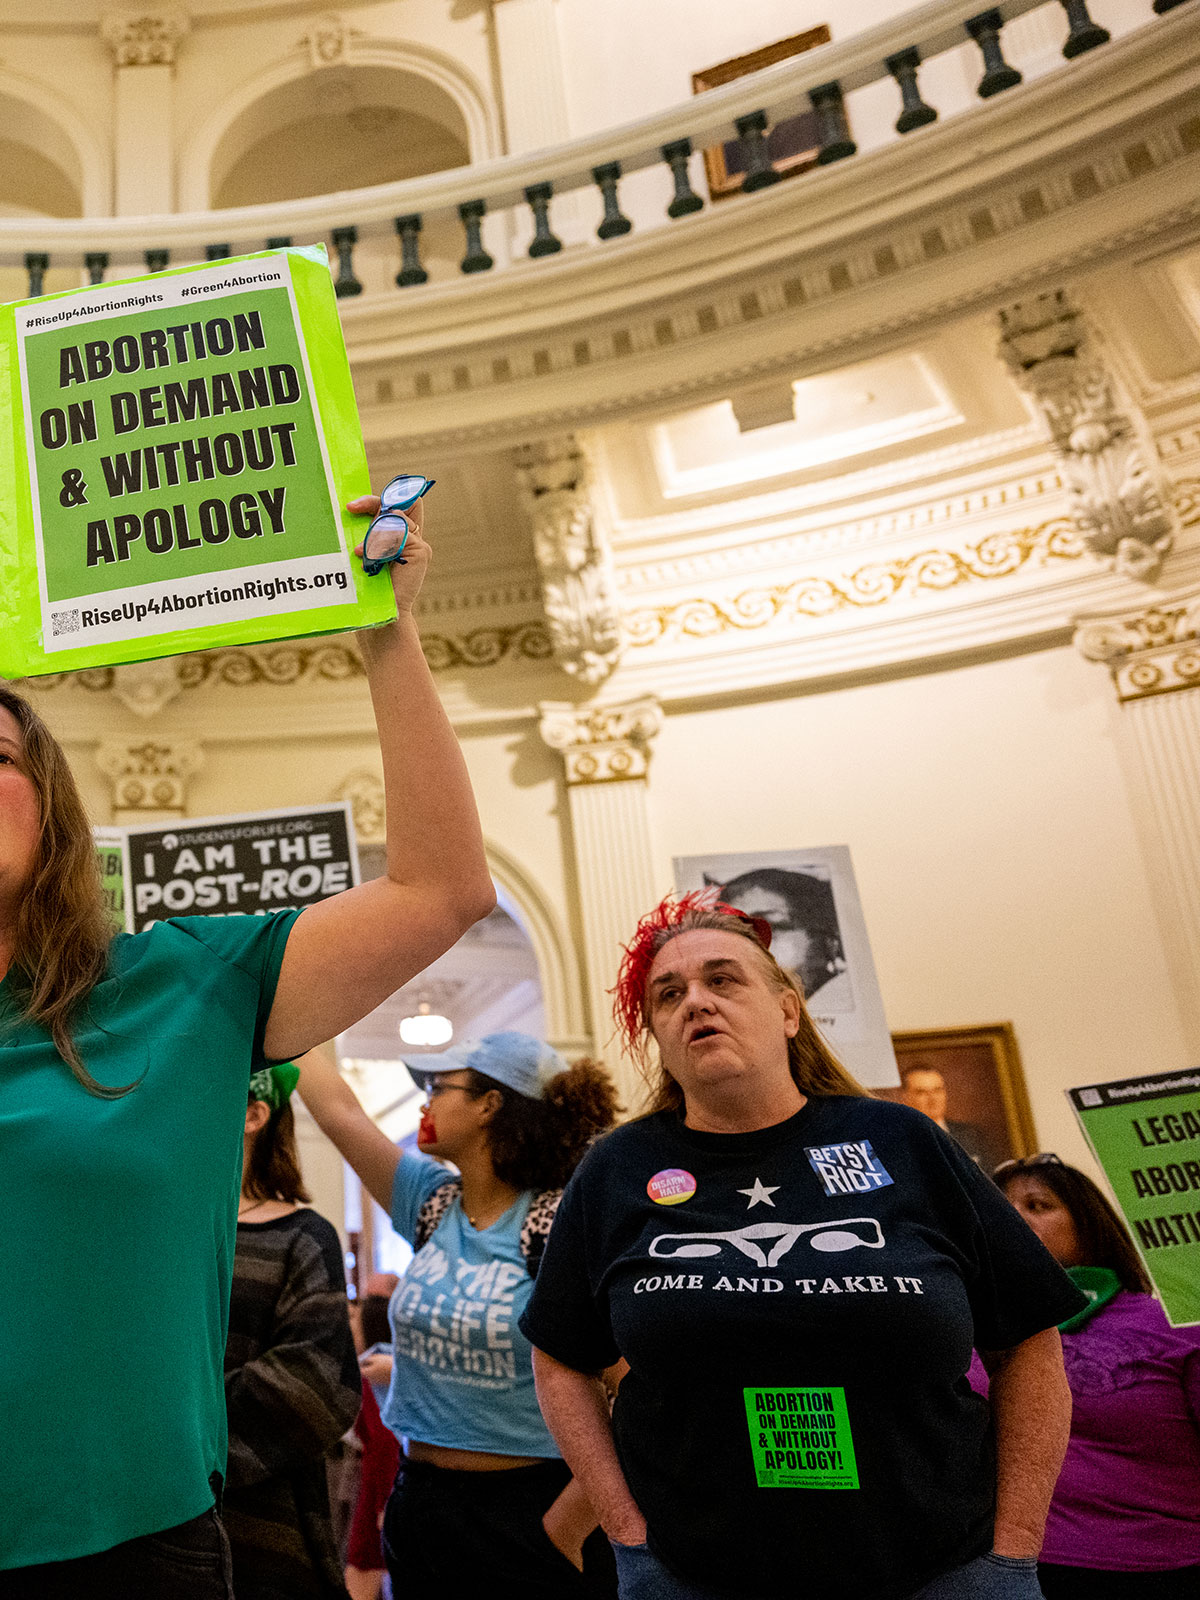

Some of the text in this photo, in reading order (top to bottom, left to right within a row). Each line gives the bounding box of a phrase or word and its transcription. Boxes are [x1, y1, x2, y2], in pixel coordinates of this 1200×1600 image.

[26, 272, 281, 328] #RiseUp4AbortionRights #Green4Abortion
[59, 311, 267, 388] ABORTION
[40, 363, 301, 450] ON DEMAND
[59, 423, 297, 509] & WITHOUT
[86, 486, 287, 567] APOLOGY
[81, 571, 347, 628] RiseUp4AbortionRights.org
[144, 833, 333, 877] I AM THE
[136, 861, 349, 914] POST-ROE
[809, 1143, 876, 1171] BETSY
[651, 1176, 685, 1191] DISARM
[660, 1185, 681, 1197] HATE
[816, 1162, 882, 1194] RIOT
[452, 1258, 525, 1302] THE
[634, 1274, 924, 1294] COME AND TAKE IT
[755, 1393, 834, 1412] ABORTION
[759, 1414, 836, 1429] ON DEMAND
[758, 1431, 837, 1448] & WITHOUT
[765, 1450, 844, 1470] APOLOGY!
